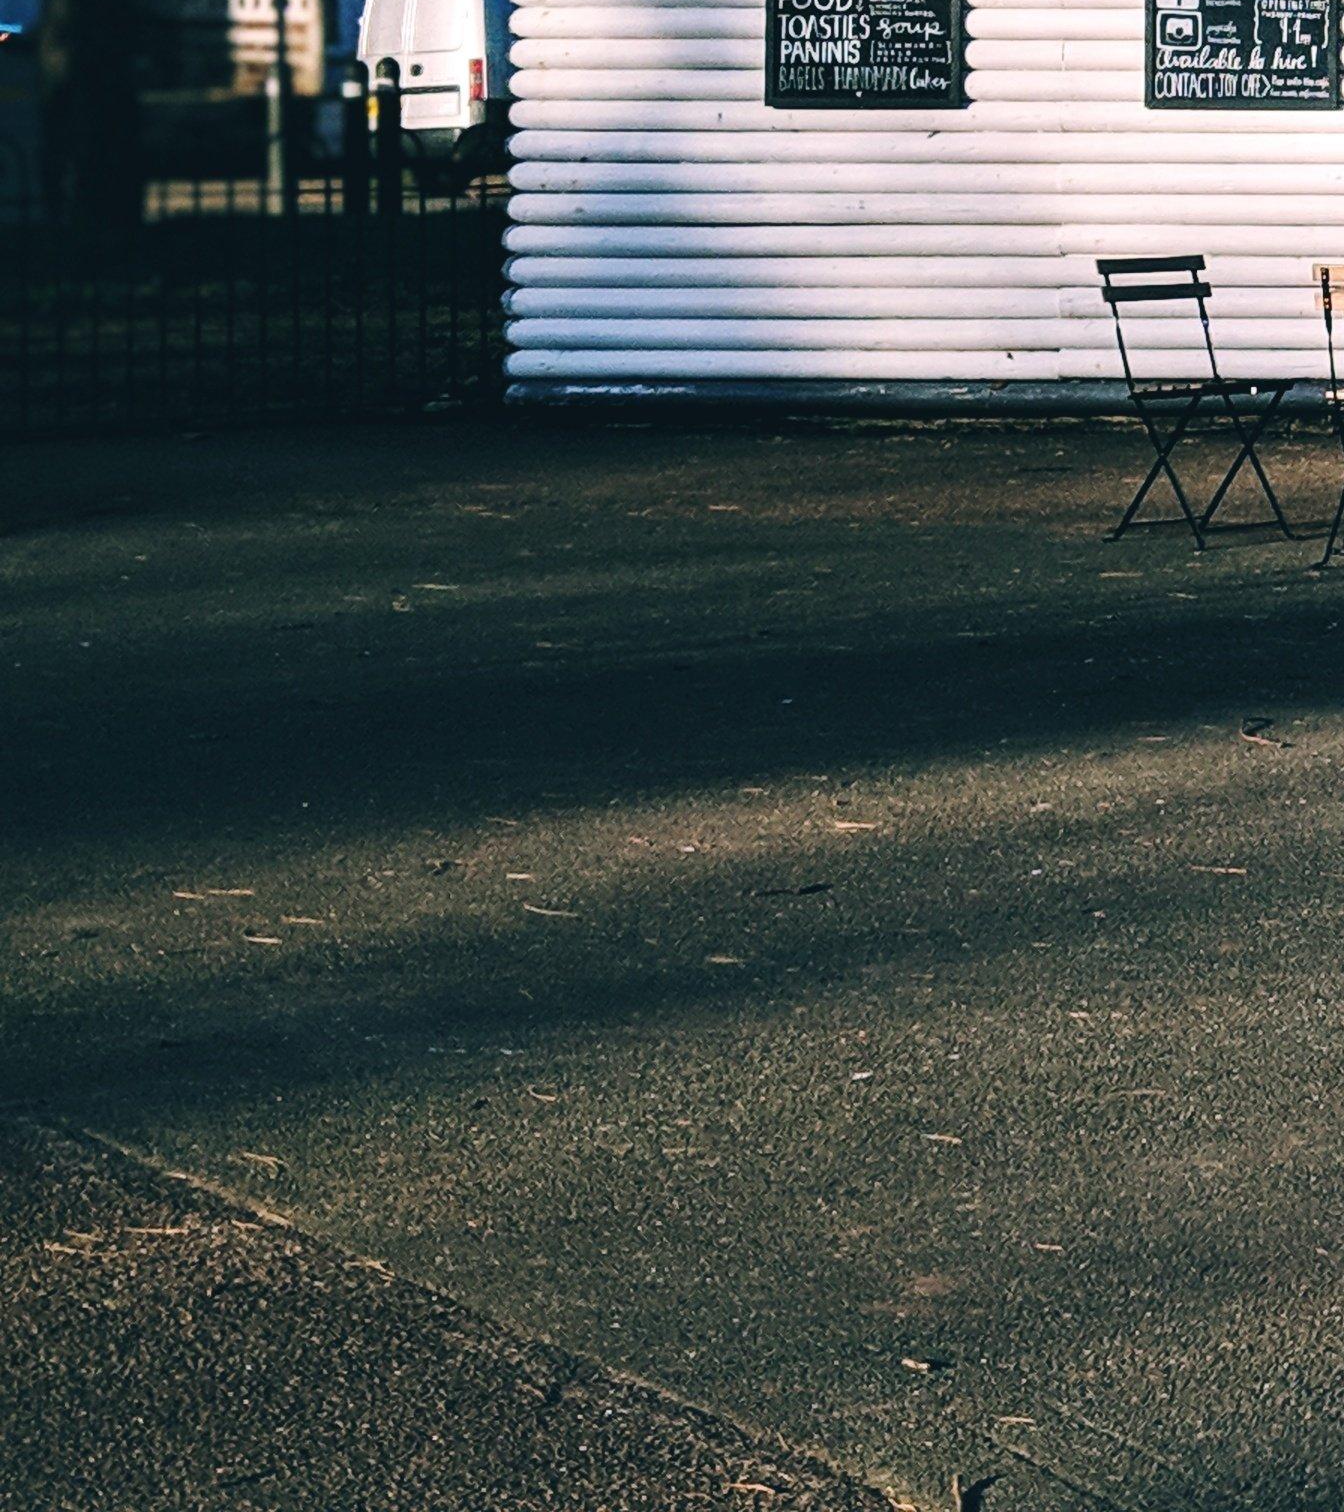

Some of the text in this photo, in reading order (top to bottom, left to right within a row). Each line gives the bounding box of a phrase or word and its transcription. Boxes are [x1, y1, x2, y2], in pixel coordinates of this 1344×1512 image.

[777, 14, 871, 40] TOASTIES
[779, 39, 862, 65] PANINIS
[1155, 44, 1243, 71] Available
[1248, 44, 1266, 70] to
[1154, 72, 1216, 100] CONTACT
